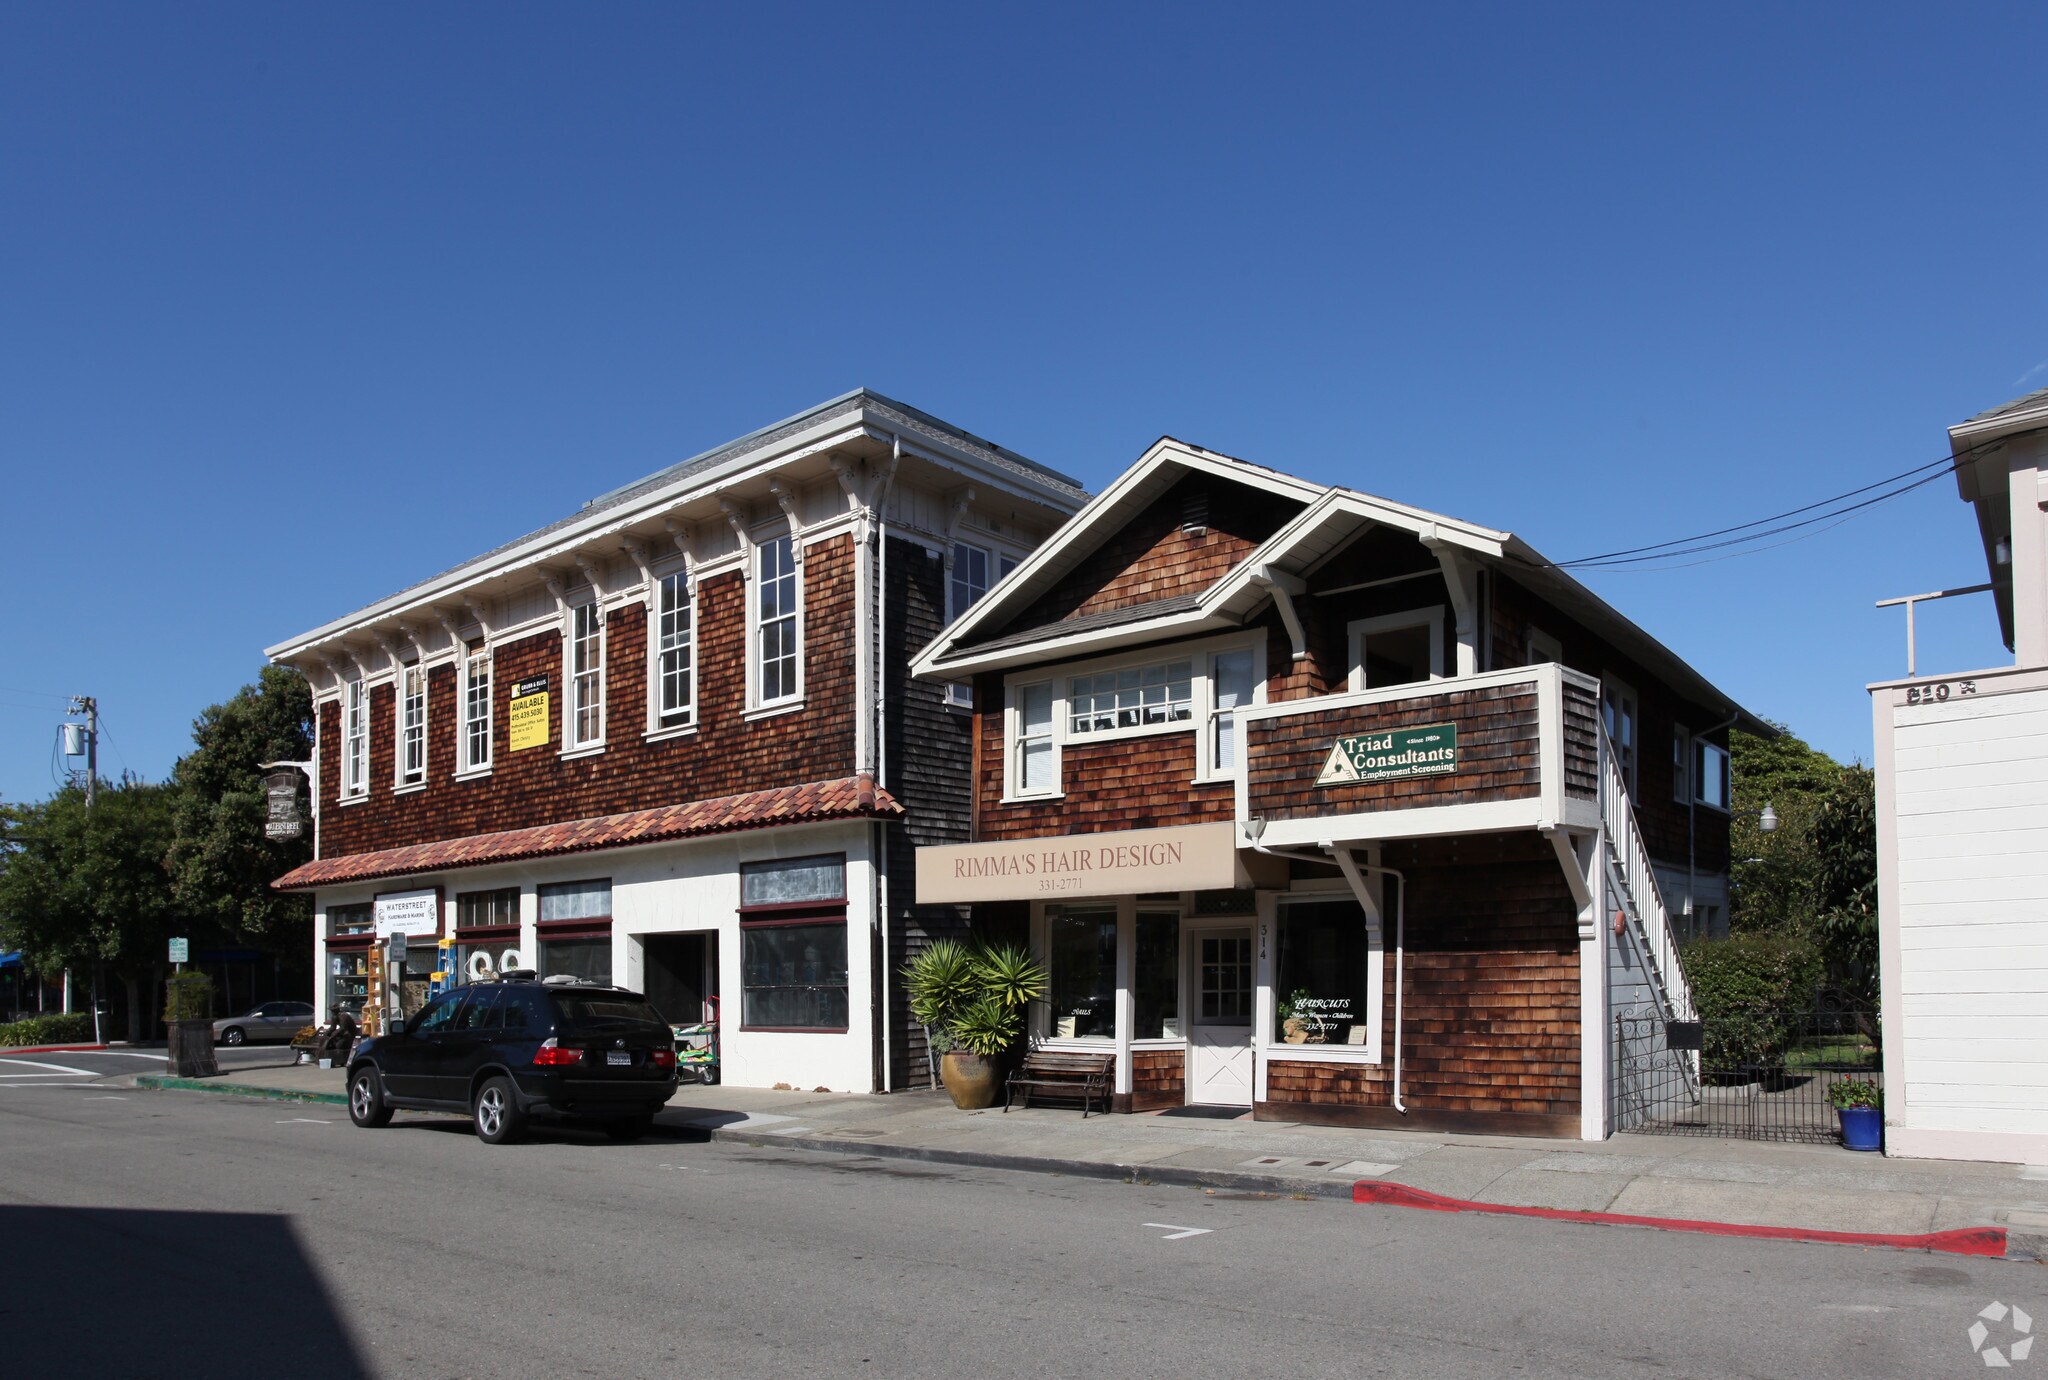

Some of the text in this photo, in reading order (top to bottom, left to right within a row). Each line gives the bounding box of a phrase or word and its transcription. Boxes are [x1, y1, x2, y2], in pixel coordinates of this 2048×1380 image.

[511, 696, 544, 712] AVAILABLE
[1344, 734, 1393, 753] Triad
[1353, 747, 1454, 769] Consultants
[1361, 762, 1455, 780] Employment Screening
[954, 841, 1184, 878] RIMMA'S HAIR DESIGN
[1038, 877, 1083, 891] 331-2771
[386, 901, 427, 911] WATERSTREET
[1260, 924, 1268, 959] 314
